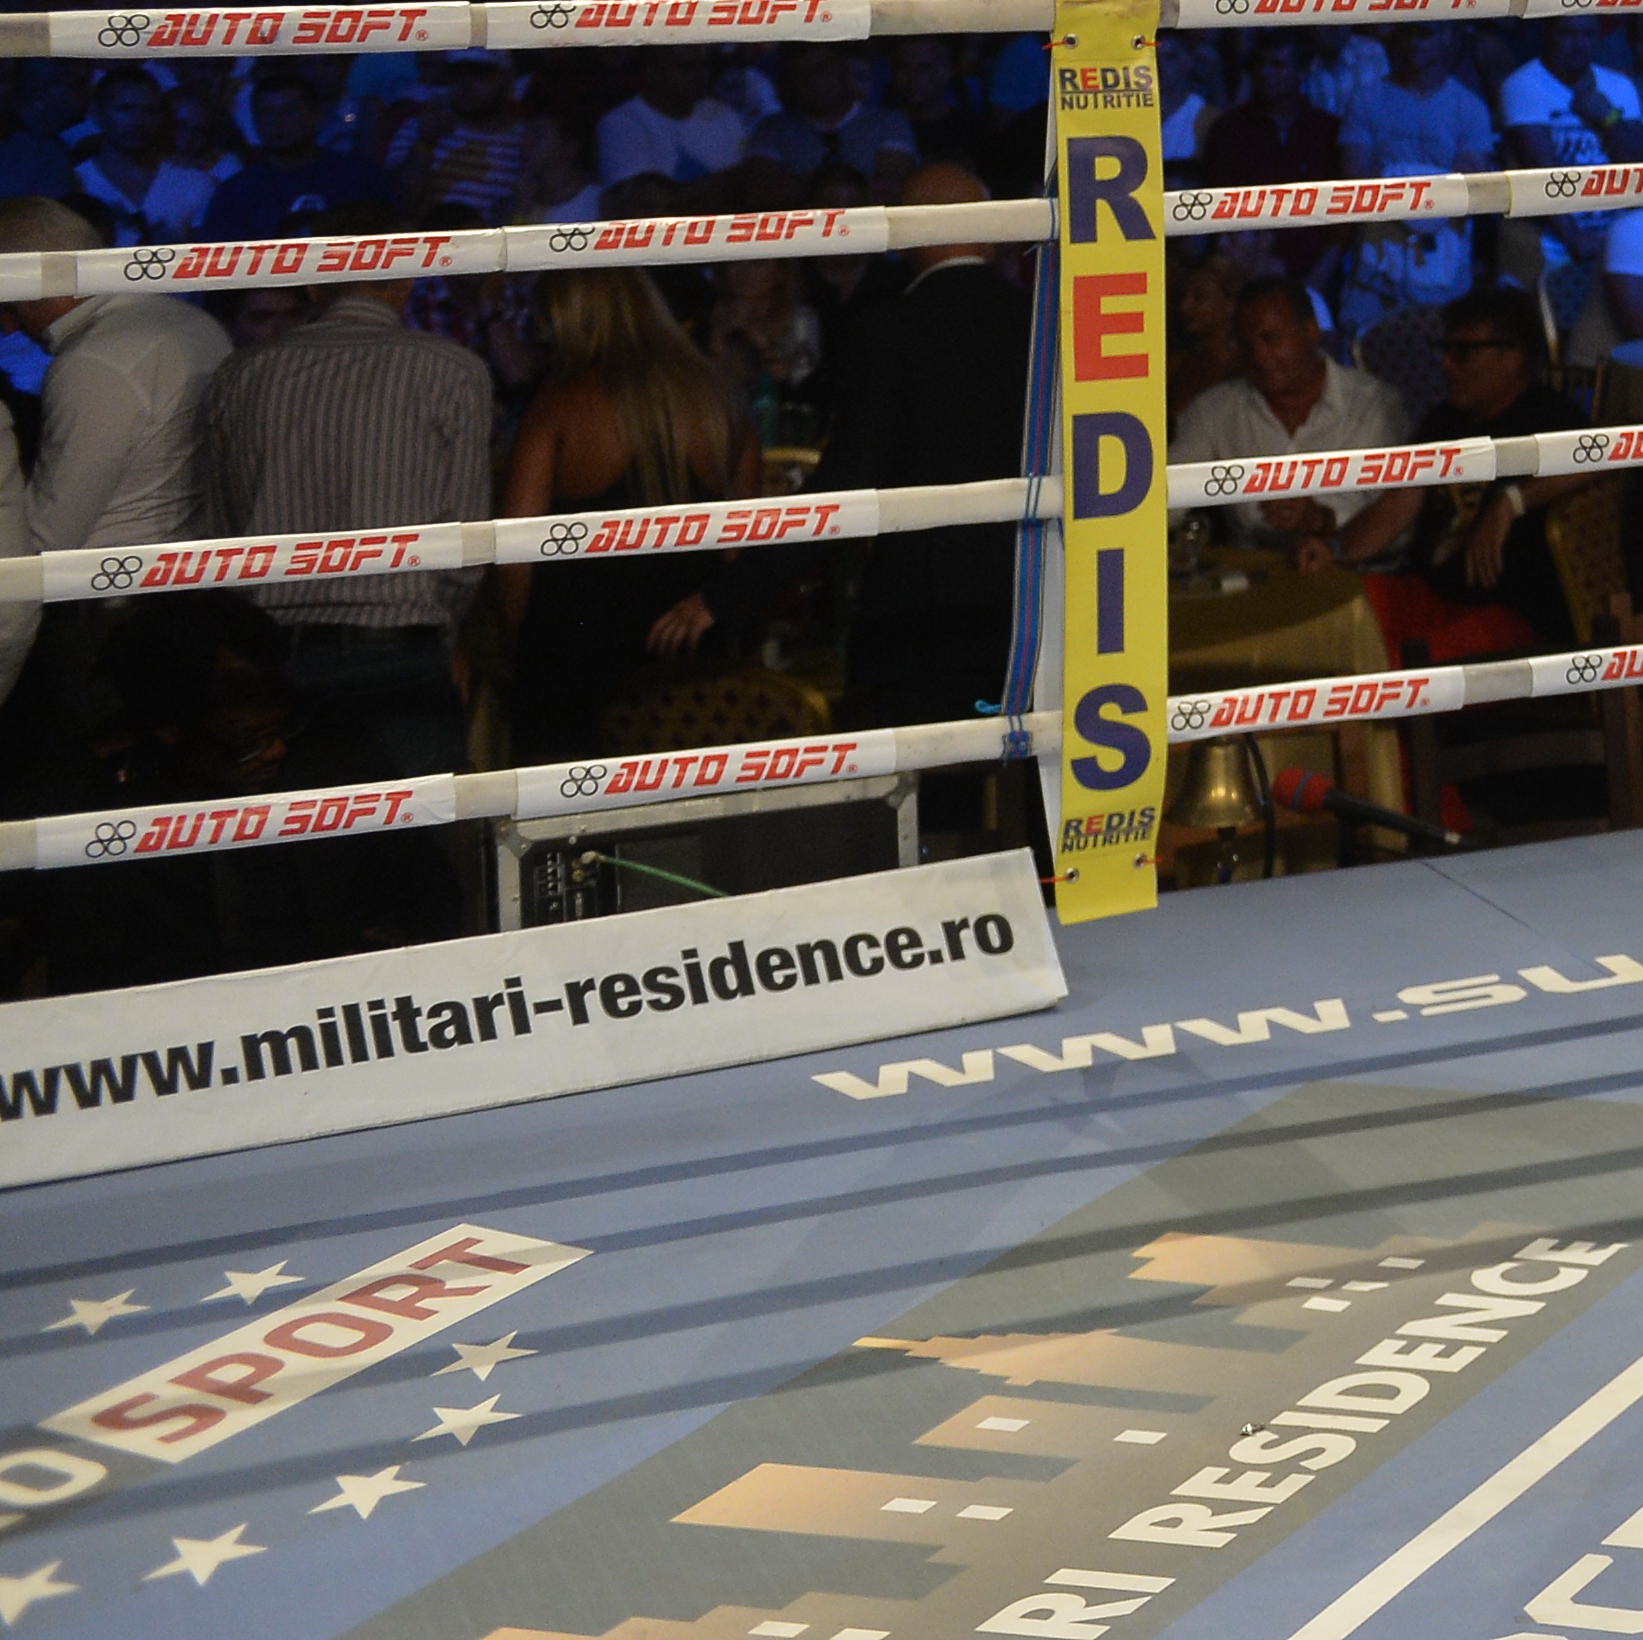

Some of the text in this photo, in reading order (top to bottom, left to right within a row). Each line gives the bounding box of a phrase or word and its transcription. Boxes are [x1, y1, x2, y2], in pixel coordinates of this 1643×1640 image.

[148, 9, 428, 46] AUTO SOFT
[576, 0, 699, 28] AUTO
[1059, 65, 1153, 92] REDIS
[1060, 91, 1155, 111] NUTRITIE
[1212, 181, 1433, 219] AUTO SOFT
[595, 210, 848, 250] AUTO SOFT
[173, 236, 451, 279] AUTO SOFT
[1066, 135, 1158, 791] REDIS
[1244, 448, 1461, 493] AUTO SOFT
[586, 504, 840, 552] AUTO SOFT
[140, 533, 420, 587] AUTO SOFT
[1210, 677, 1430, 727] AUTO SOFT
[605, 743, 858, 794] AUTO SOFT
[135, 790, 413, 852] AUTO SOFT
[1061, 807, 1156, 838] REDIS
[1061, 827, 1154, 855] NUTRITIE
[0, 911, 1015, 1122] www.militari-residence.ro
[91, 1236, 532, 1444] SPORT
[1108, 1237, 1631, 1548] RESIDENCE
